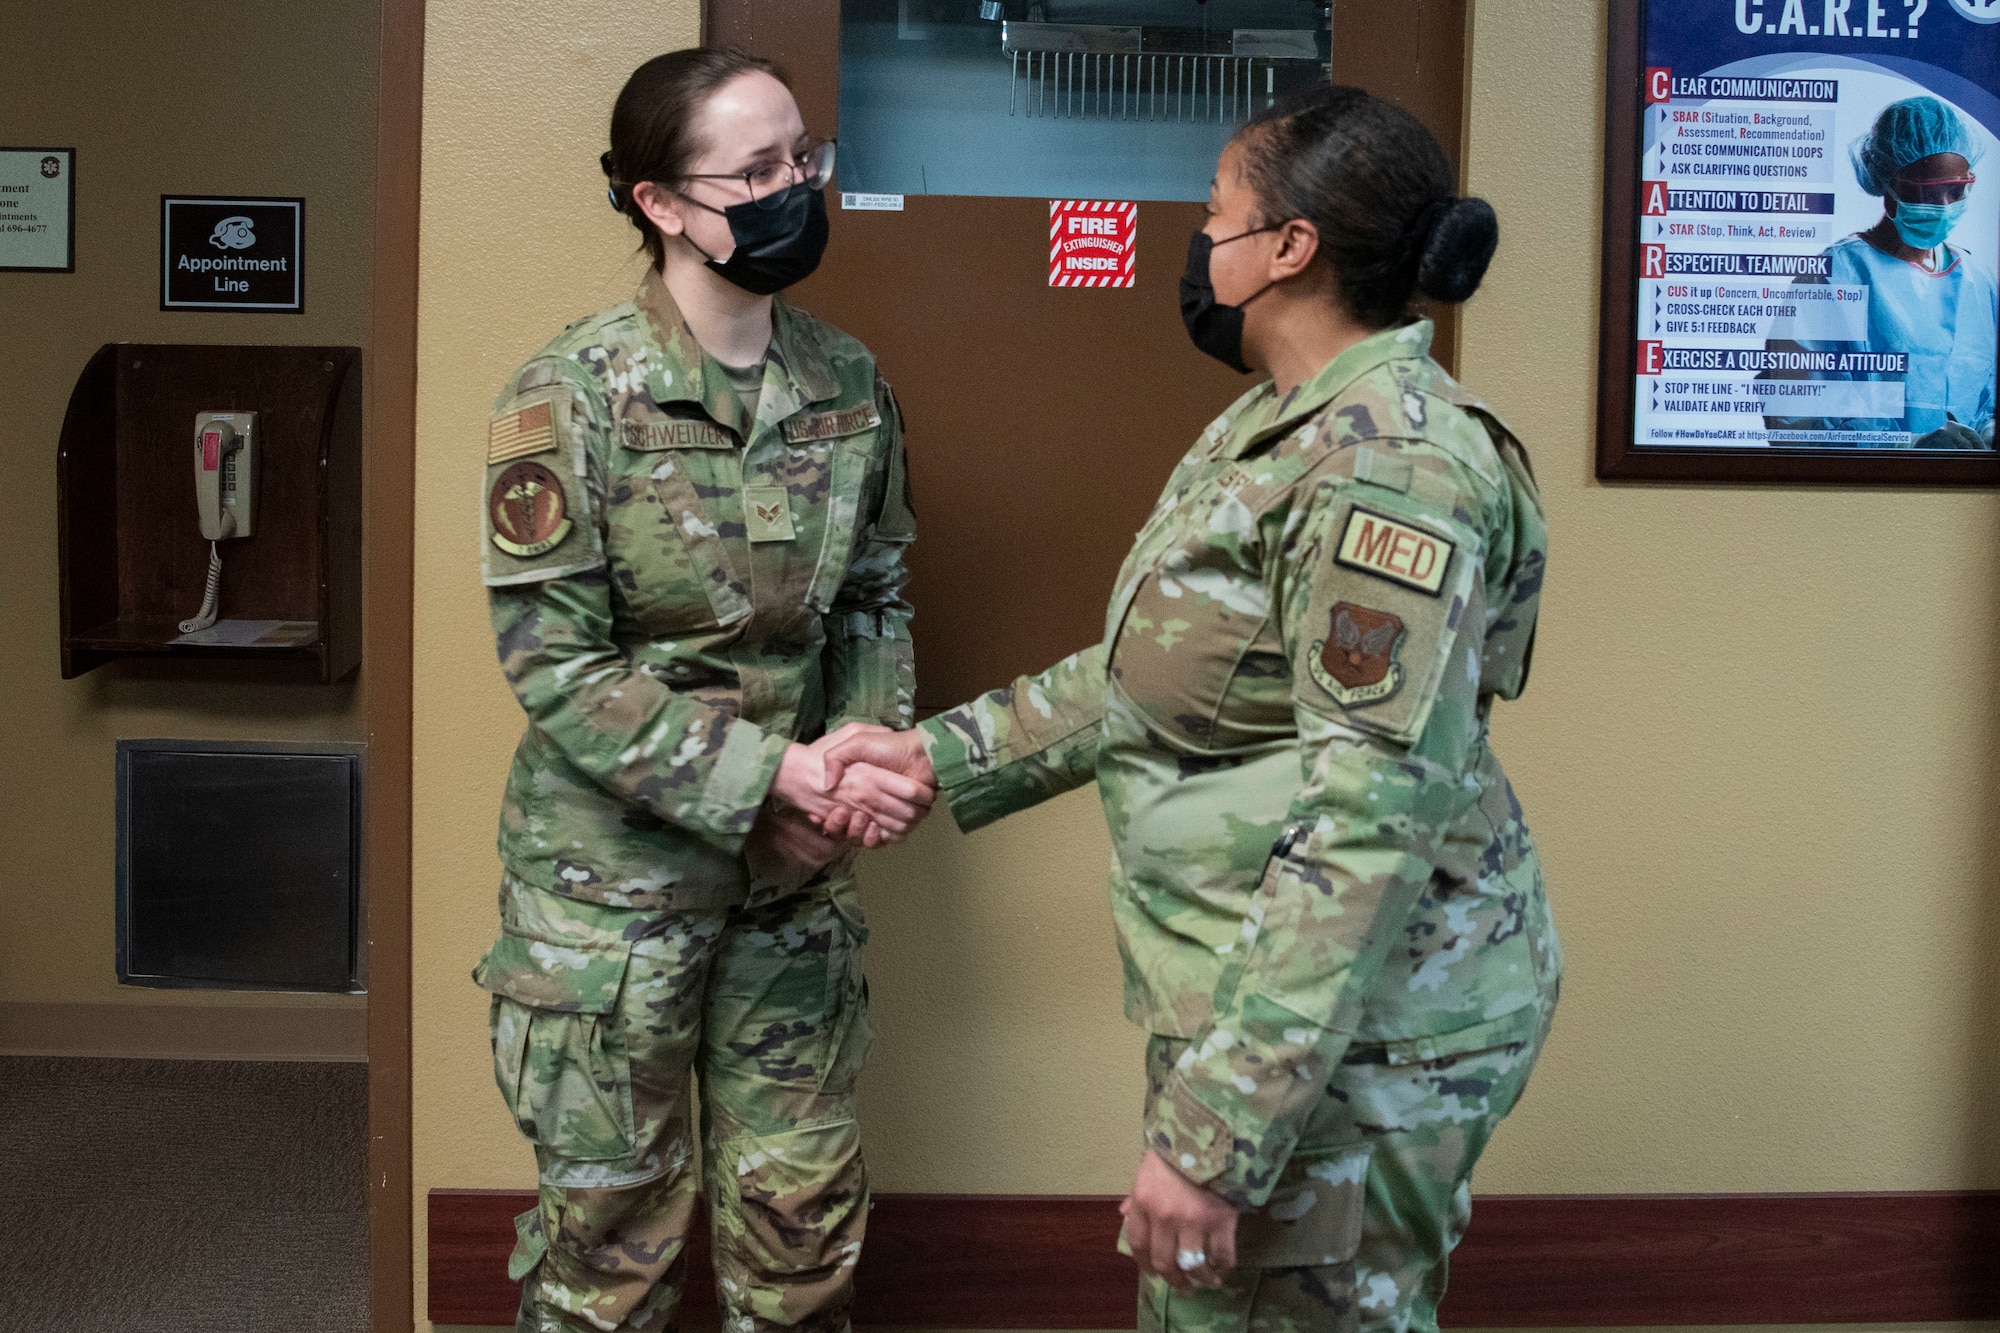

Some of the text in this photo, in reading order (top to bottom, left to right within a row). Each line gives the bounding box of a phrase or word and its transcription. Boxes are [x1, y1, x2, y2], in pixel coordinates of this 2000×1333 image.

[1735, 0, 1927, 38] C.A.R.E.?
[1711, 78, 1834, 99] COMMUNICATION
[1673, 111, 1812, 127] SBAR (Situation, Background,
[1677, 126, 1825, 141] Assessment, Recommendation)
[1672, 143, 1823, 158] CLOSE COMMUNICATION LOOPS
[1671, 163, 1807, 177] ASK CLARIFYING QUESTIONS
[1740, 192, 1758, 210] TO
[1762, 193, 1809, 211] DETAIL
[1068, 217, 1118, 235] FIRE
[1669, 223, 1816, 238] STAR (Stop, Think, Act, Review)
[1063, 237, 1124, 255] EXTINGUISHER
[178, 255, 287, 272] Appointment
[1066, 257, 1118, 270] INSIDE
[1746, 256, 1827, 275] TEAMWORK
[214, 277, 249, 292] Line
[1667, 285, 1863, 302] CUS it up (Concern, Uncomfortable, Stop)
[1667, 303, 1797, 317] CROSS-CHECK EACH OTHER
[1666, 321, 1756, 334] GIVE 5:1 FEEDBACK
[1725, 351, 1735, 368] A
[1739, 352, 1835, 371] QUESTIONING
[1838, 353, 1905, 372] ATTITUDE
[1665, 383, 1689, 394] STOP
[1692, 383, 1709, 394] THE
[1712, 384, 1732, 394] LINE
[1753, 384, 1776, 396] NEED
[1665, 400, 1766, 412] VALIDATE AND VERIFY
[630, 423, 724, 447] SCHWEITZER
[1651, 429, 1673, 438] Follow
[1675, 430, 1736, 439] #HowDoYouCARE
[1738, 431, 1745, 439] at
[1353, 519, 1436, 580] MED
